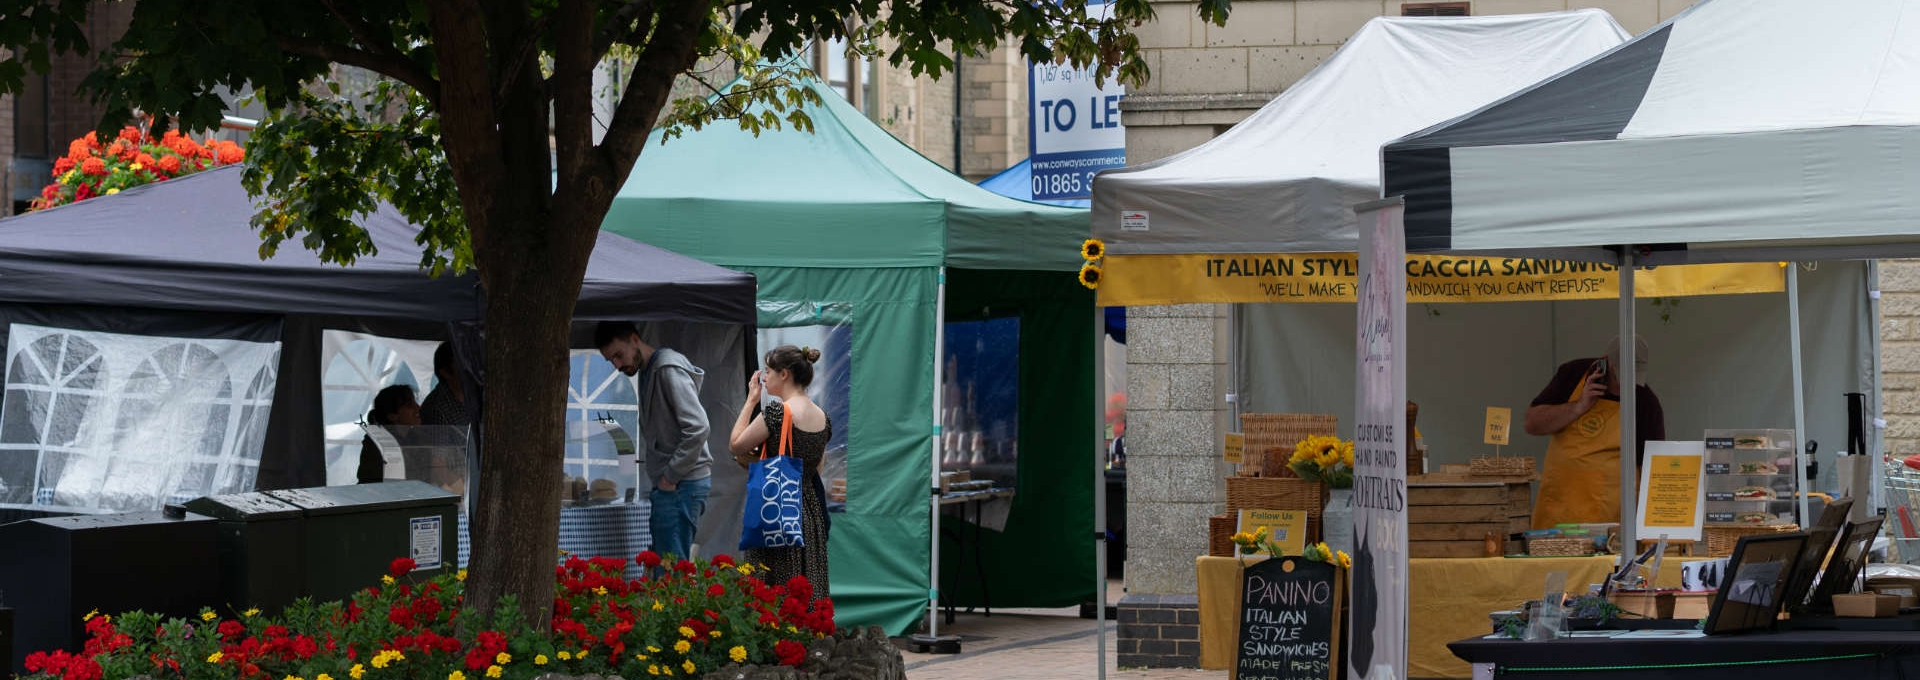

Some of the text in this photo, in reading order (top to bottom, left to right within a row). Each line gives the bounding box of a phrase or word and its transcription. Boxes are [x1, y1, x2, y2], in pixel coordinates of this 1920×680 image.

[1062, 70, 1071, 83] sq
[1040, 94, 1126, 133] TO LE
[1032, 155, 1126, 170] www.conwayscommercia
[1032, 172, 1081, 195] 01865
[1207, 258, 1294, 278] ITALIAN
[1405, 259, 1494, 278] CACCIA
[1259, 282, 1304, 297] "WE'LL
[1309, 280, 1346, 297] MAKE
[1406, 281, 1470, 297] ANDWICH
[1474, 282, 1502, 296] YOU
[1507, 281, 1545, 295] CAN'T
[1550, 278, 1605, 294] REFUSE"
[761, 456, 785, 547] BLOOM
[781, 472, 805, 547] SBURY
[1251, 511, 1294, 520] Follow Us
[1246, 575, 1330, 606] PANINO
[1246, 608, 1308, 625] ITALIAN
[1249, 625, 1302, 642] STYLE
[1243, 641, 1329, 659] SANDWICHES
[1240, 658, 1330, 673] MADE FRESH
